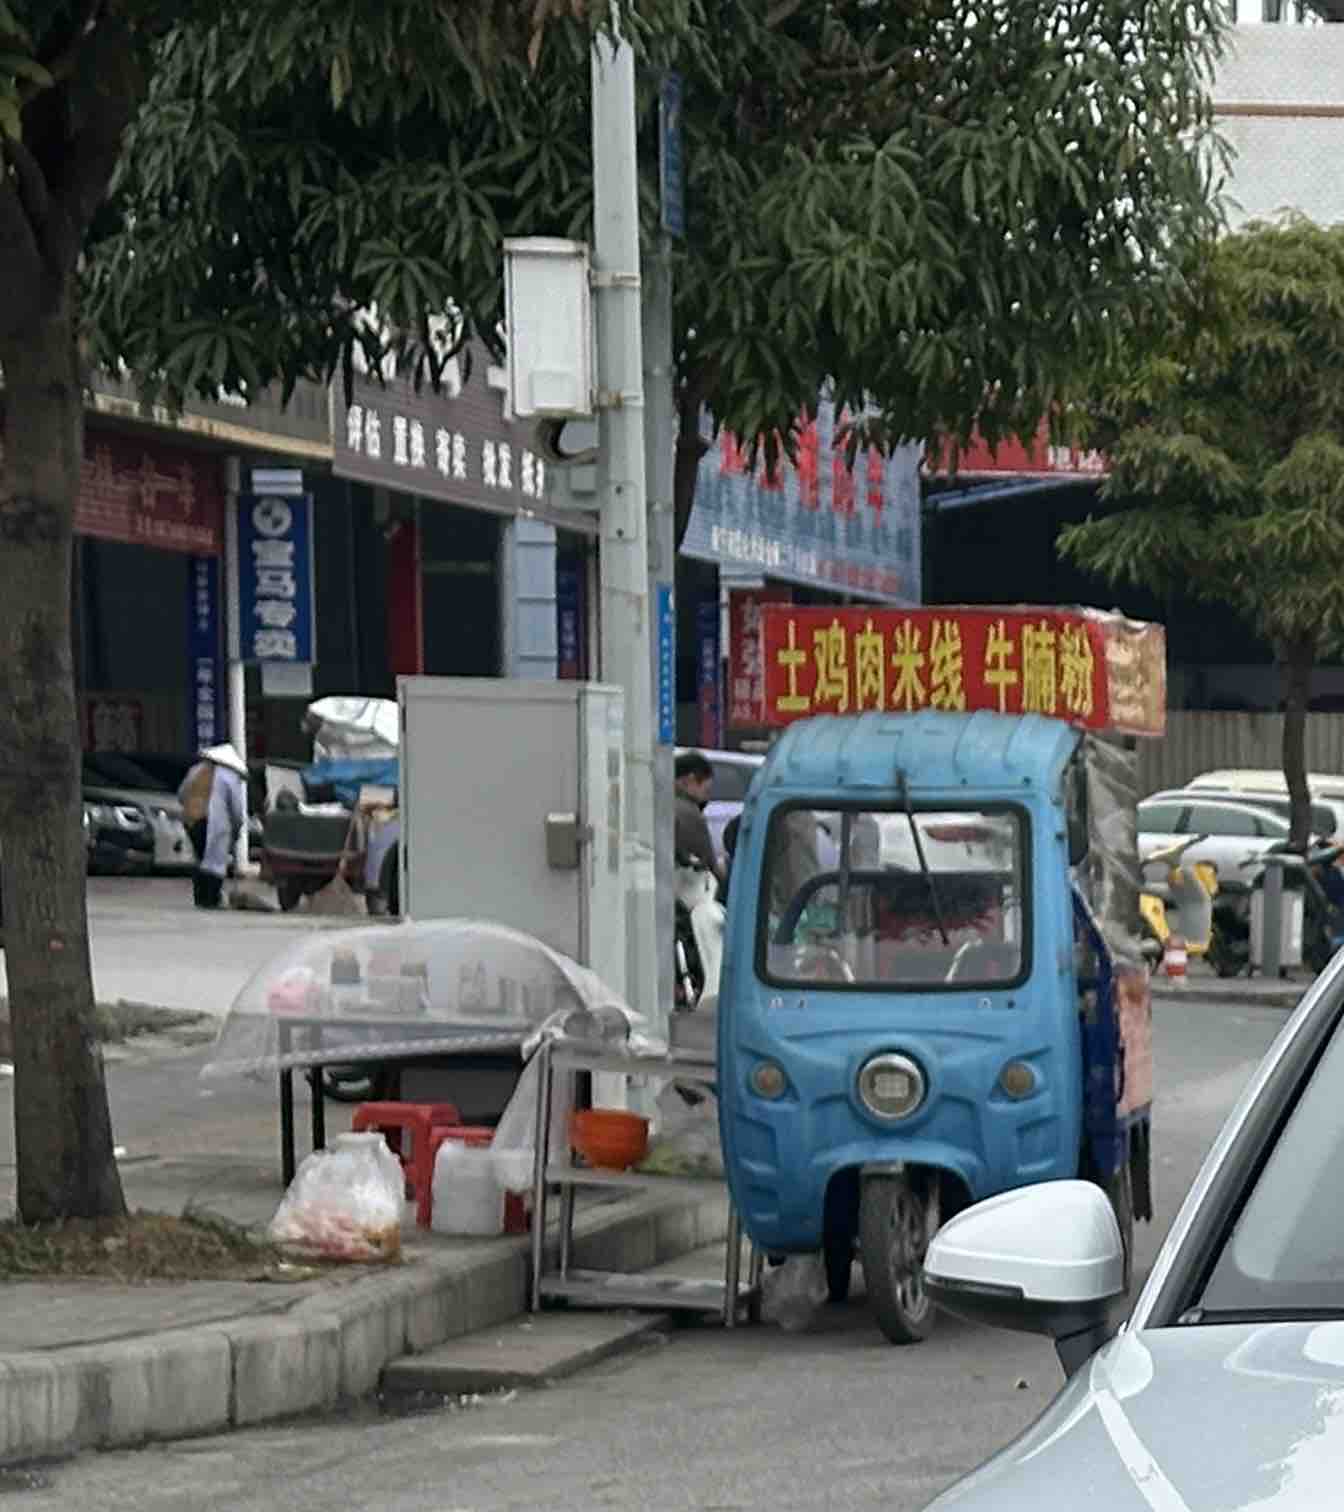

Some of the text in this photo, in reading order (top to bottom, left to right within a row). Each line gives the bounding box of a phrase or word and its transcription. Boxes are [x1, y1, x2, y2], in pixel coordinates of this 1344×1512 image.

[776, 618, 967, 713] 土鸡肉米线
[983, 618, 1095, 716] 牛腩粉
